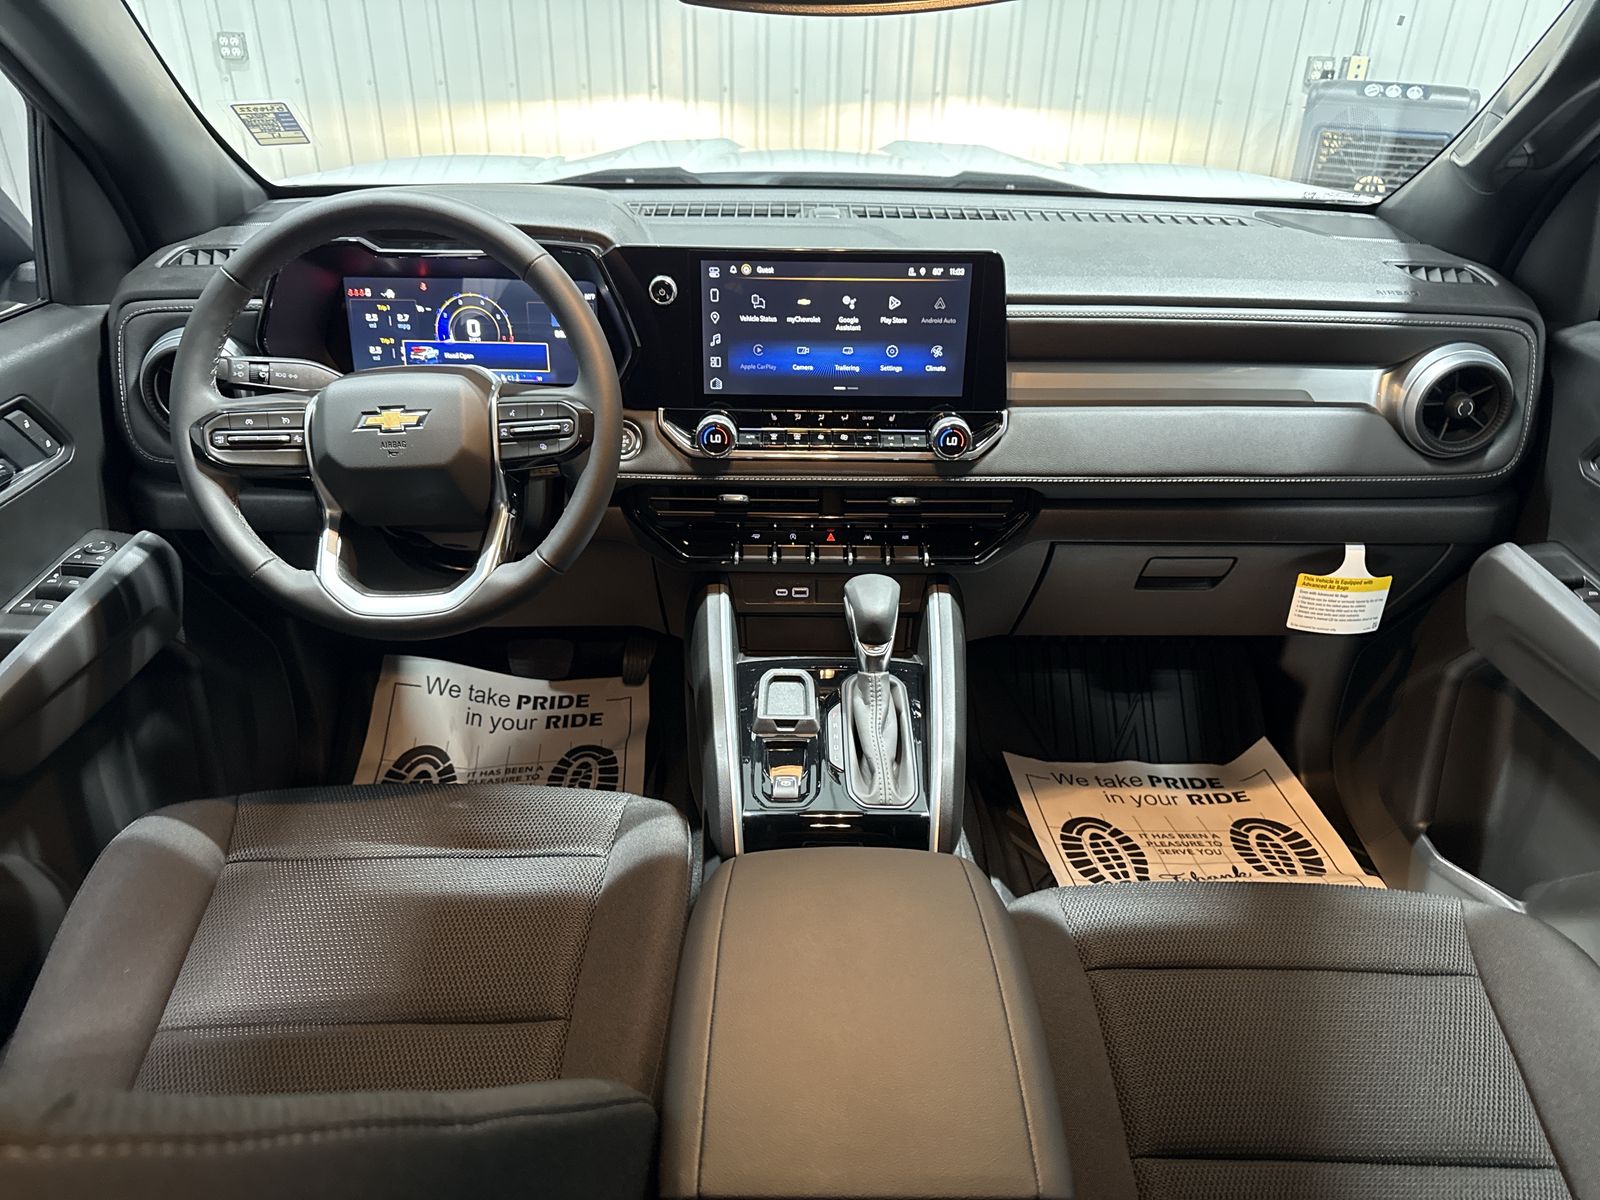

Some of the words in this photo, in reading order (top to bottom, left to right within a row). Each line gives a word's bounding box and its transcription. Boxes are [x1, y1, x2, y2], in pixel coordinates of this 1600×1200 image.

[757, 266, 774, 274] Guest
[739, 315, 759, 323] Vehicle
[760, 315, 777, 323] Status
[786, 316, 821, 324] myChevrolet
[838, 316, 859, 325] Google
[880, 316, 891, 325] Play
[466, 318, 481, 337] 0
[836, 324, 861, 332] Assistant
[459, 352, 475, 360] Open
[740, 363, 756, 371] Apple
[756, 363, 777, 371] CarPlay
[834, 364, 860, 373] Trailering
[880, 364, 902, 373] Settings
[925, 364, 947, 372] Climate
[380, 440, 407, 449] AIRBAG
[946, 436, 958, 446] LO
[1302, 582, 1327, 590] Advanced
[426, 675, 461, 698] We
[468, 684, 511, 708] take
[516, 694, 590, 711] PRIDE
[465, 707, 482, 727] in
[488, 716, 538, 735] your
[545, 712, 604, 730] RIDE
[466, 770, 477, 778] IT
[480, 768, 502, 777] HAS
[504, 766, 534, 775] BEEN
[468, 776, 522, 785] PLEASURE
[526, 773, 540, 781] TO
[1050, 771, 1089, 787] We
[1096, 774, 1143, 788] take
[1147, 774, 1225, 790] PRIDE
[1102, 790, 1125, 804] in
[1132, 793, 1178, 809] your
[1187, 790, 1251, 806] RIDE
[1146, 840, 1205, 848] PLEASURE
[1158, 848, 1196, 856] SERVE
[1197, 848, 1223, 856] YOU
